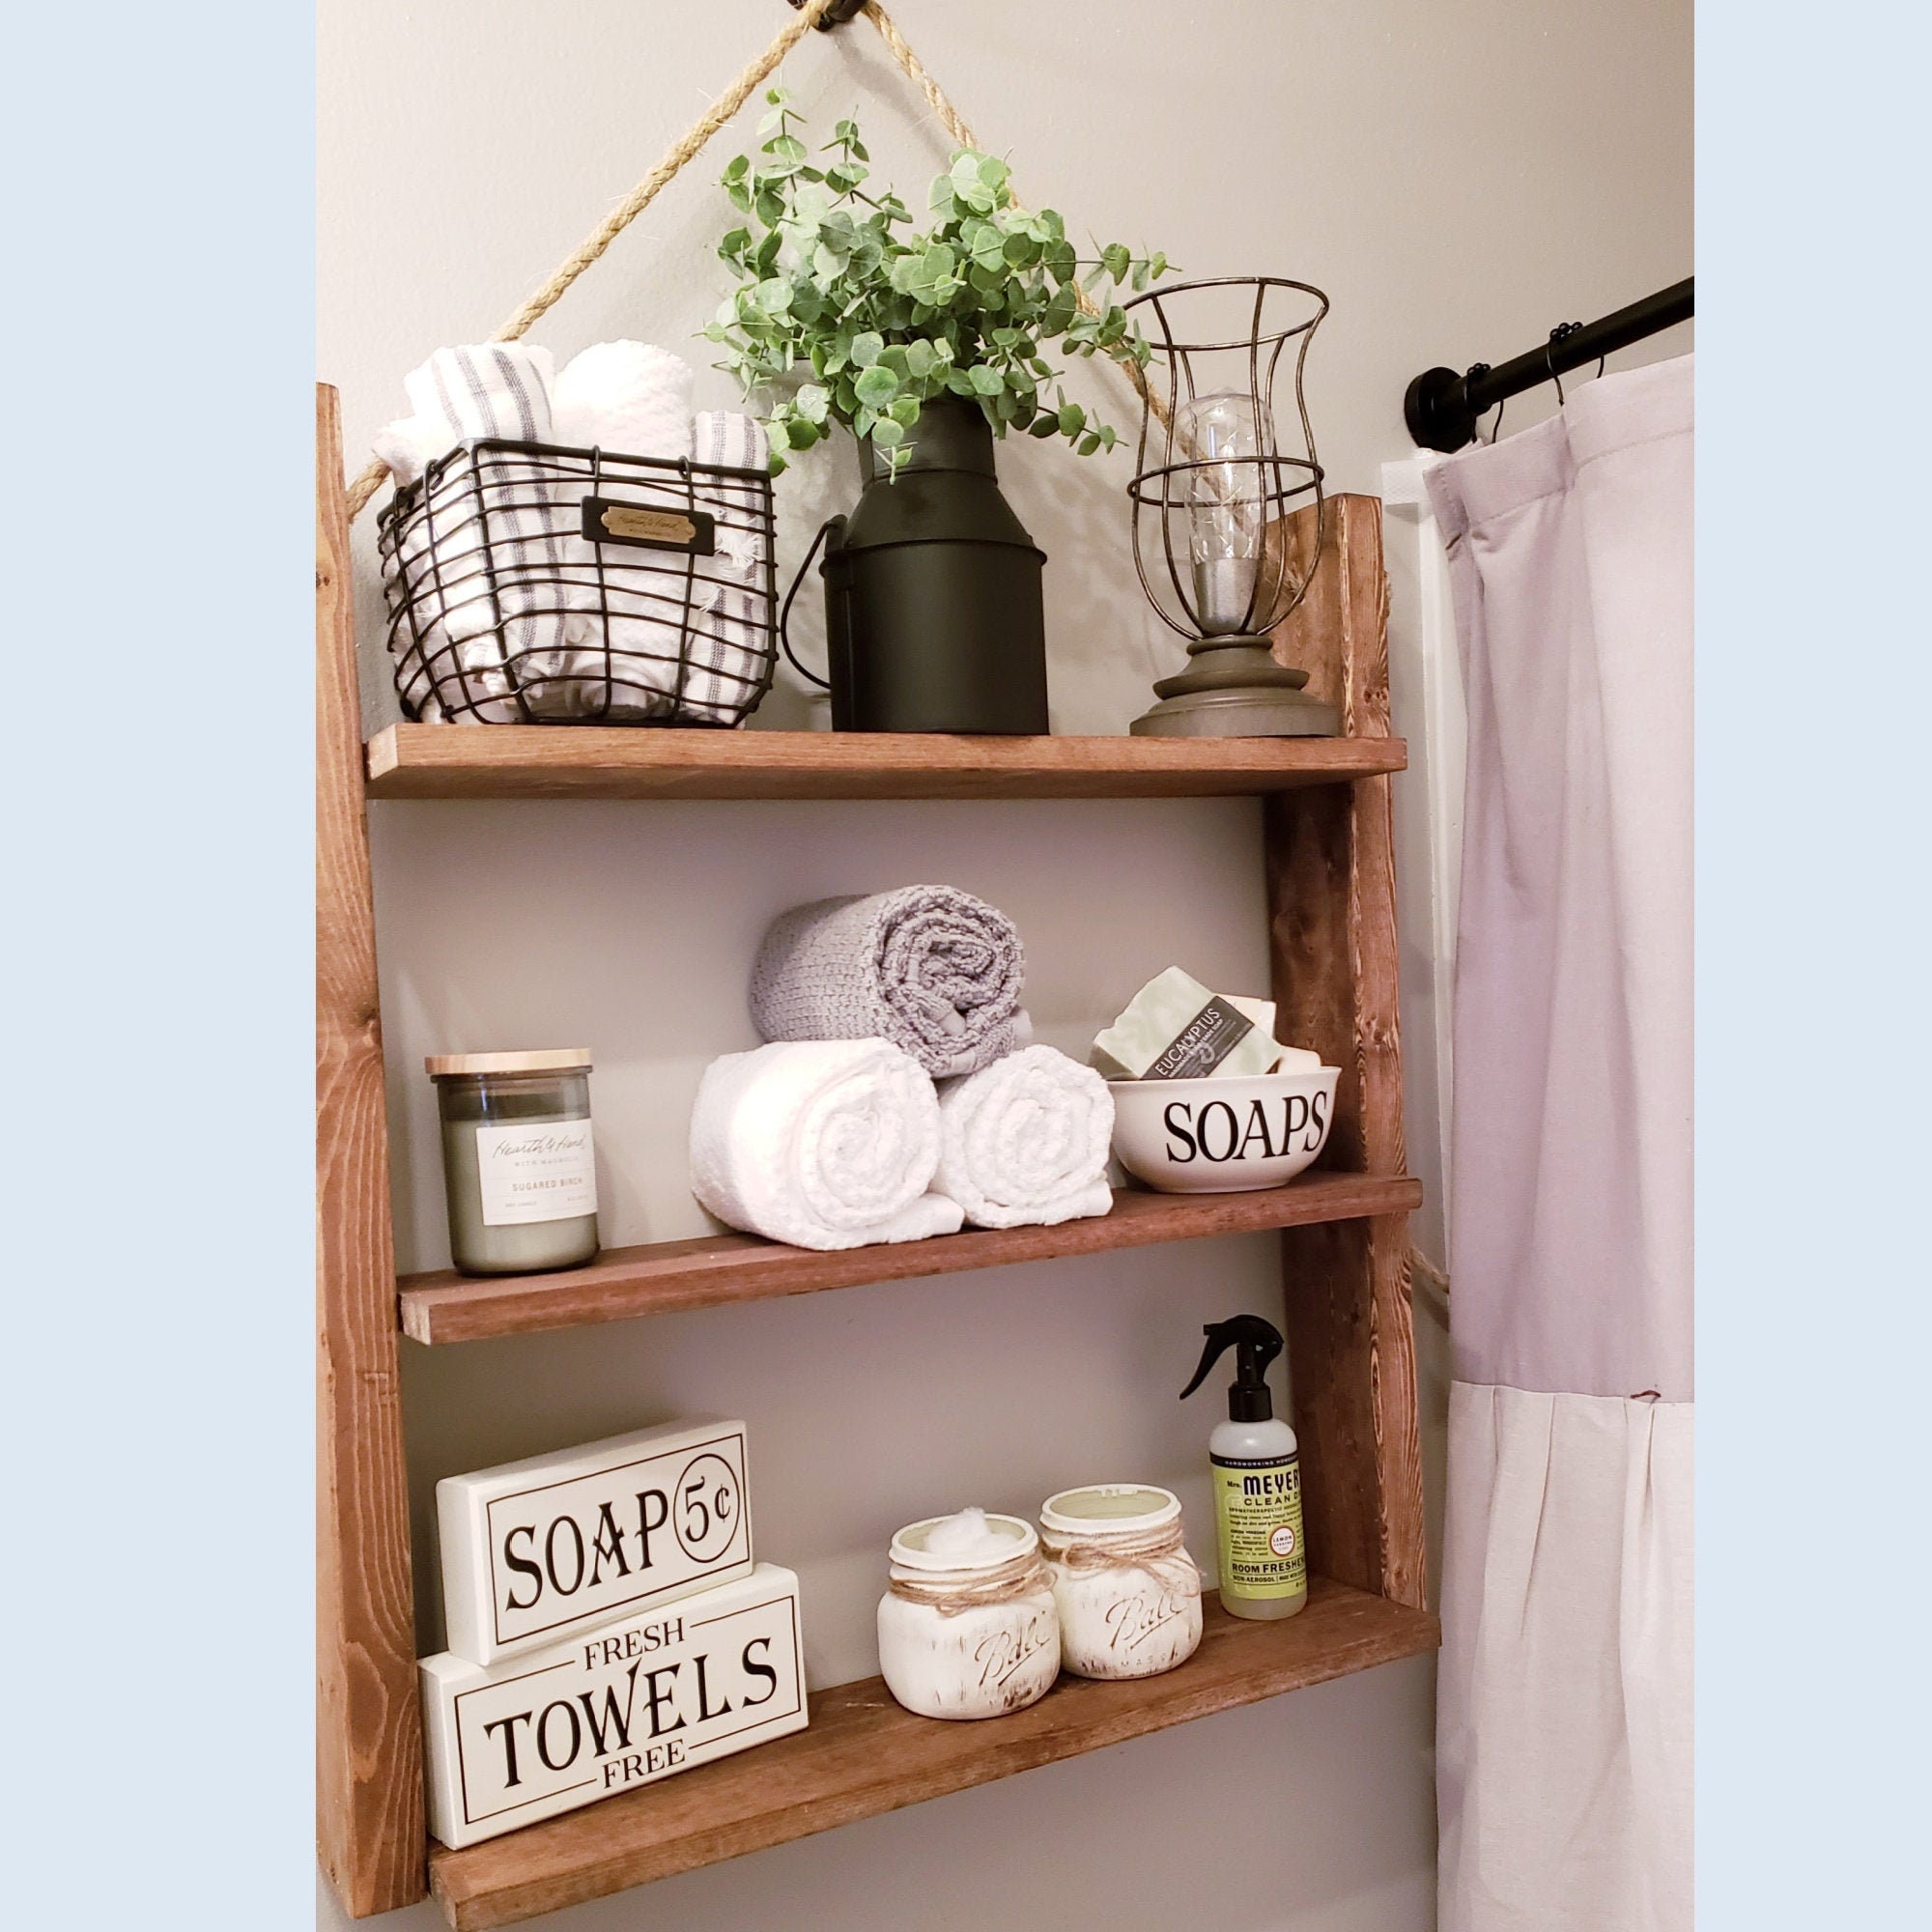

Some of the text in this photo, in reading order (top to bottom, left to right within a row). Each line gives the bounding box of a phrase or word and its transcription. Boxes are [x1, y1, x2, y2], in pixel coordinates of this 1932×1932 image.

[1154, 1008, 1220, 1076] EUCALYPTUS
[1163, 1091, 1328, 1162] SOAPS
[512, 1180, 556, 1192] SUGARED
[1244, 1494, 1291, 1506] CLEAN
[503, 1488, 669, 1612] SOAP
[1233, 1563, 1260, 1574] ROOM
[582, 1617, 686, 1671] FRESH
[482, 1637, 779, 1789] TOWELS
[601, 1738, 687, 1789] FREE
